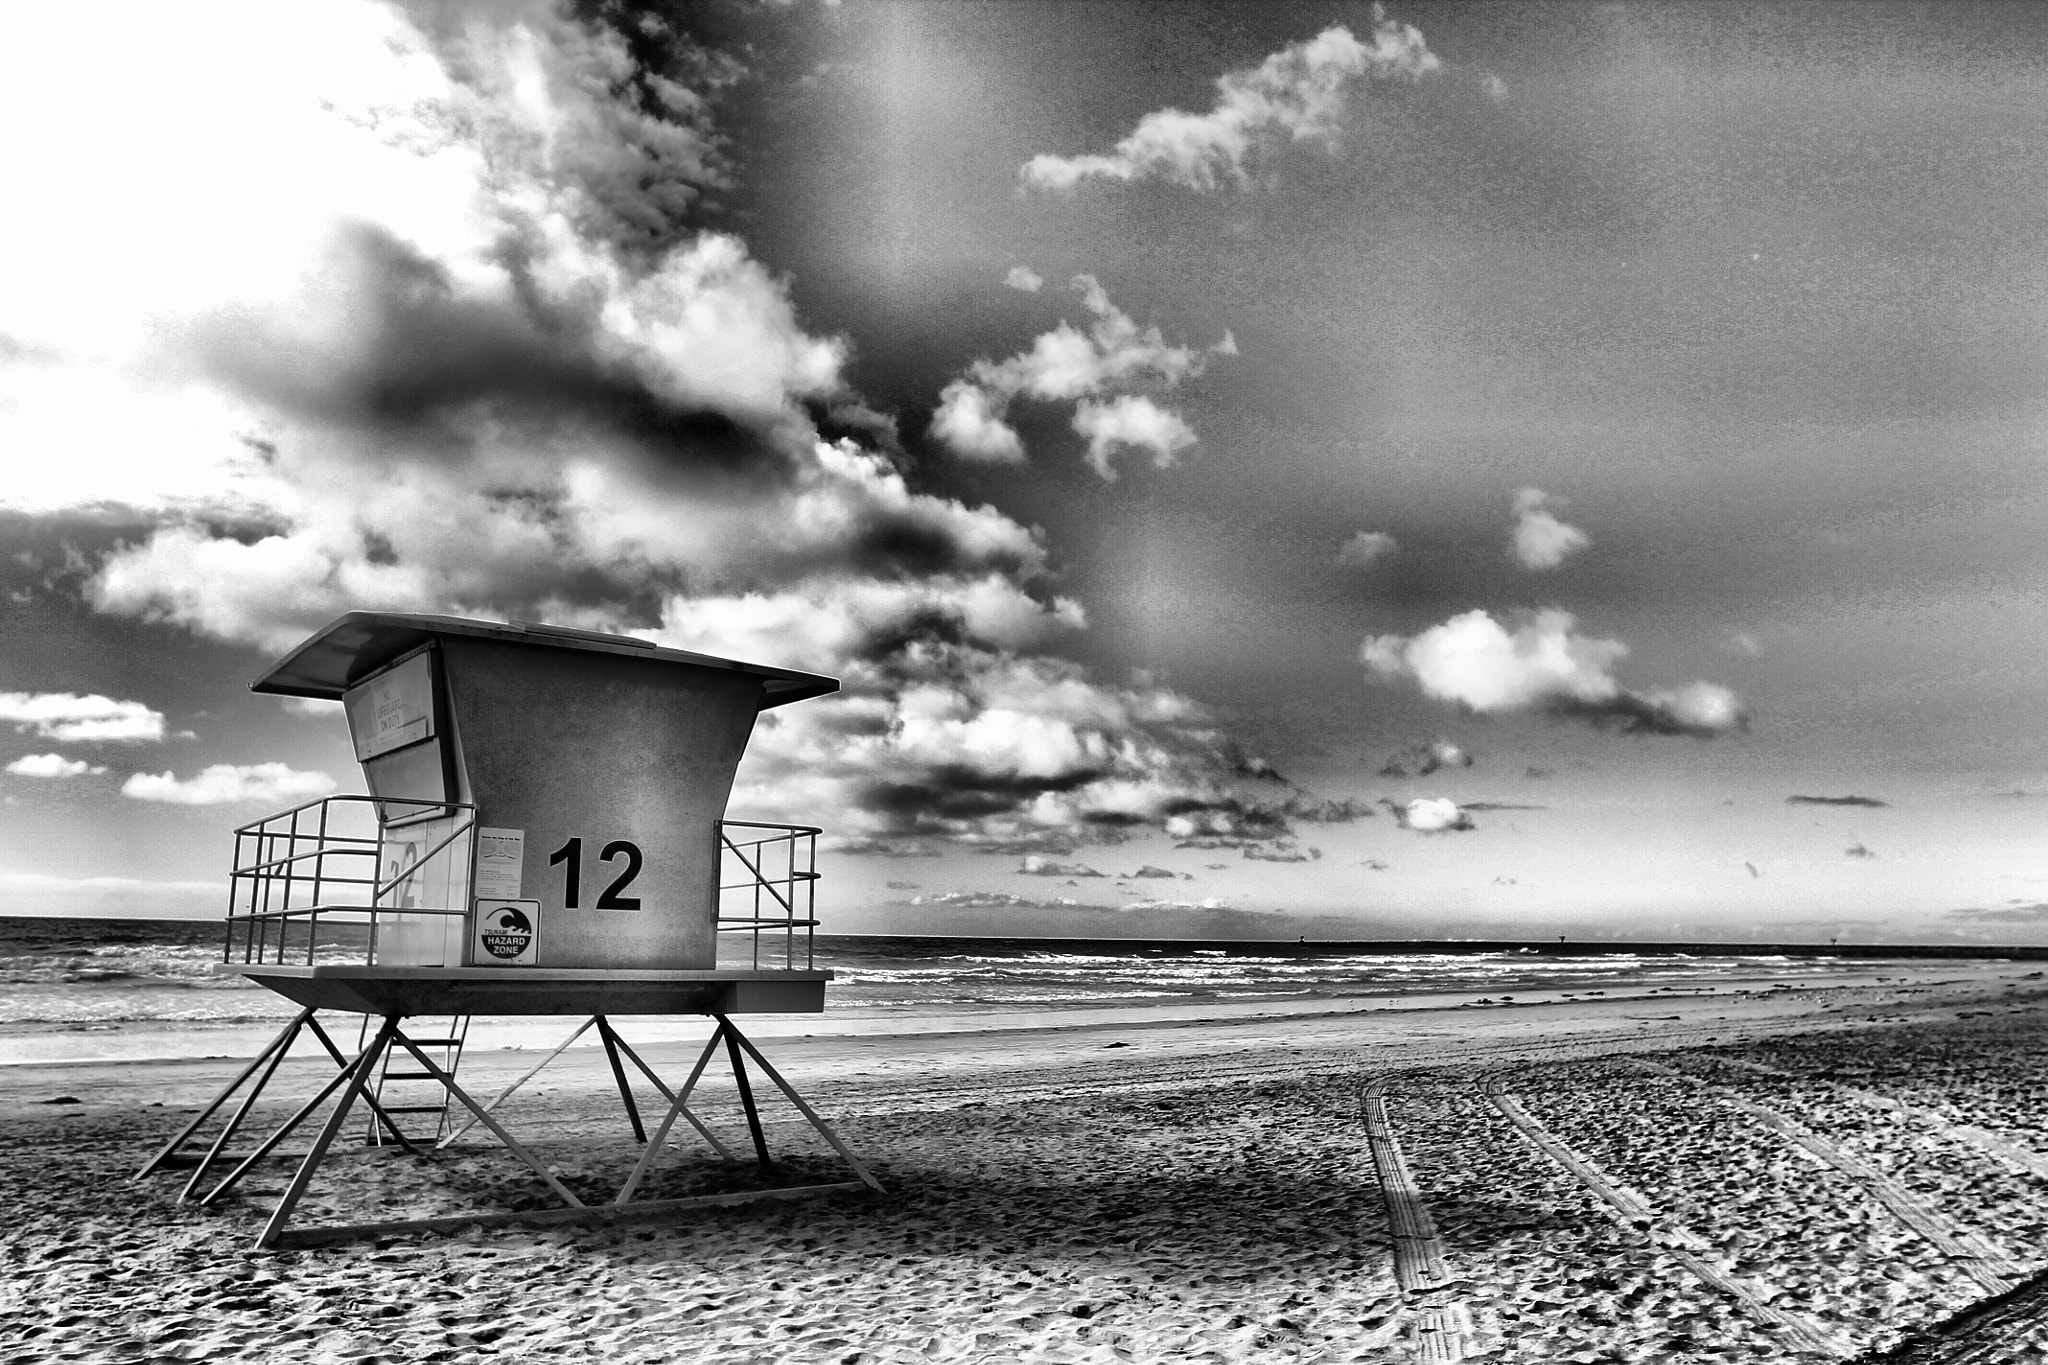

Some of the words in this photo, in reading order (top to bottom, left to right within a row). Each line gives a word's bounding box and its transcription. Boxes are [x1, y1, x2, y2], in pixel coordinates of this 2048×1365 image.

[390, 841, 417, 908] 12
[550, 837, 643, 911] 12
[487, 936, 526, 945] HAZARD
[493, 945, 519, 954] ZONE
